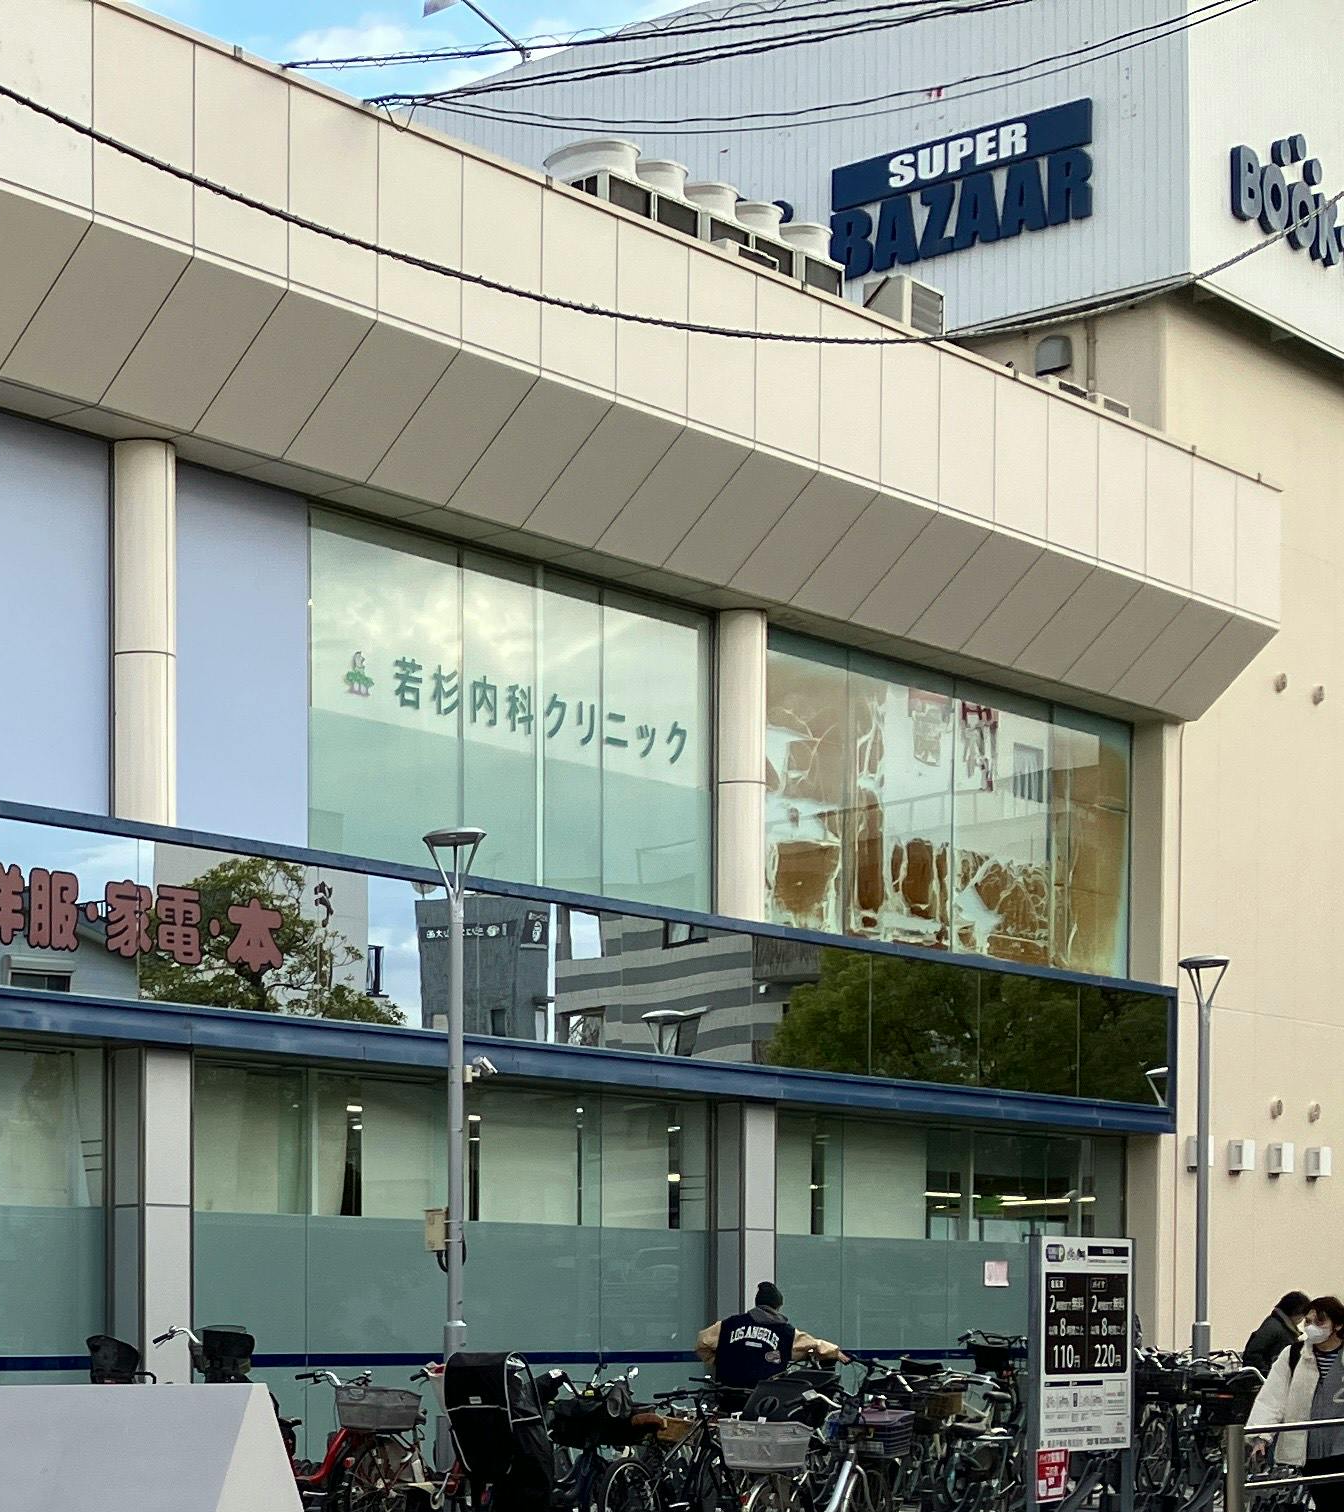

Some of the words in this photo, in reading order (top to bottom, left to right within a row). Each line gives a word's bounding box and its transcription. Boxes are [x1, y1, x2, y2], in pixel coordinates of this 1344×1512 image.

[889, 122, 1028, 188] SUPER
[830, 149, 1093, 281] BAZAAR
[394, 656, 687, 764] 若杉内科クリニック
[729, 1326, 745, 1344] LOS
